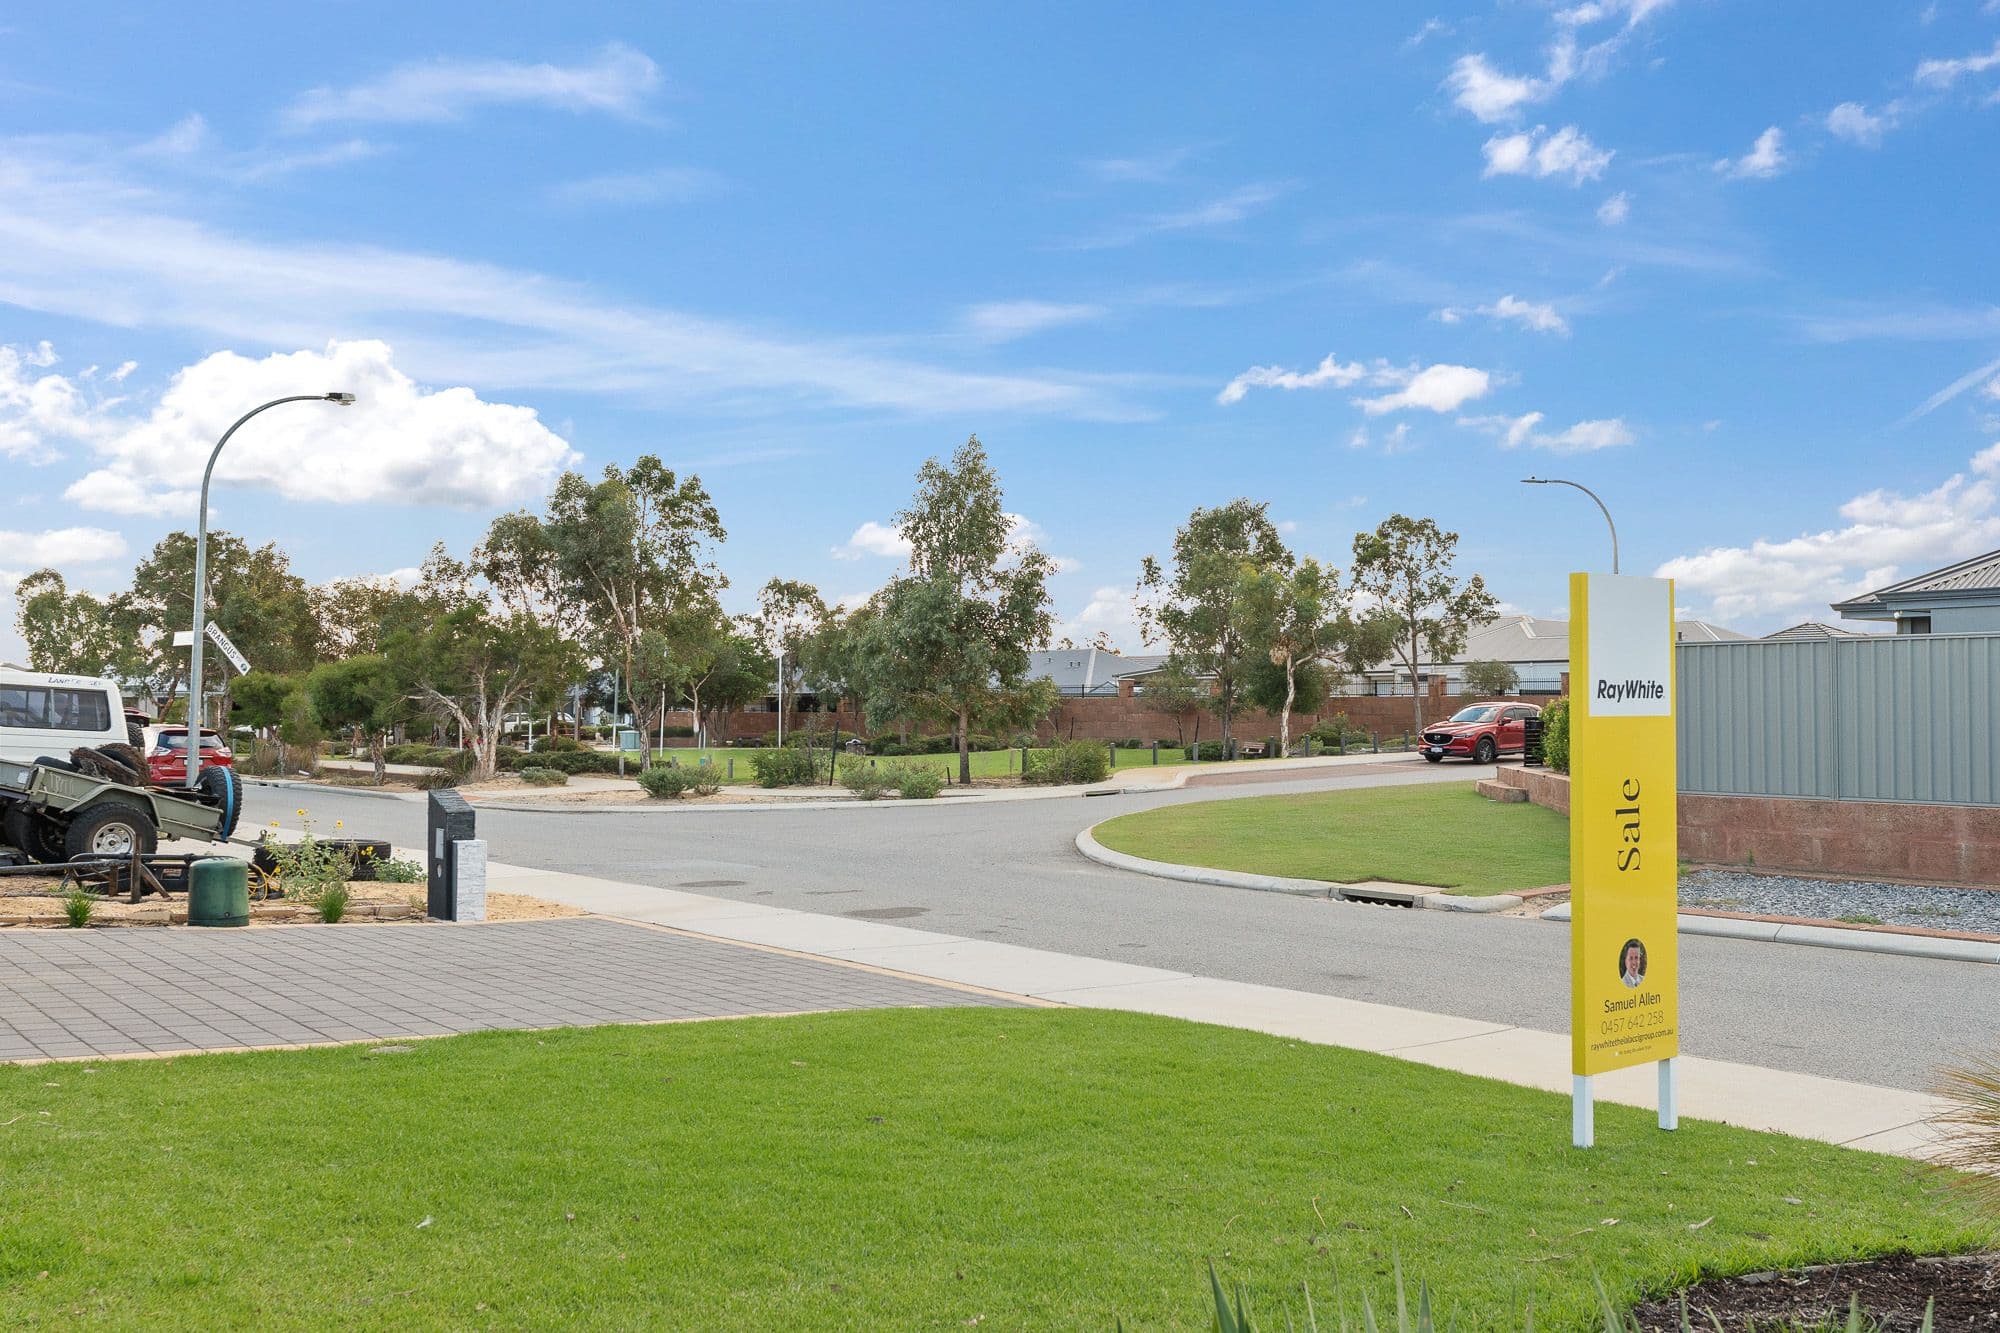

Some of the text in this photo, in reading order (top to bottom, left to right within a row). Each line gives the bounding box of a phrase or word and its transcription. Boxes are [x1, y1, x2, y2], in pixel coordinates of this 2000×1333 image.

[207, 624, 237, 659] BRANGUS
[1616, 778, 1640, 871] Sale
[1604, 992, 1661, 1013] Samuel Allen
[1601, 1017, 1625, 1035] 0457
[1627, 1014, 1646, 1030] 642
